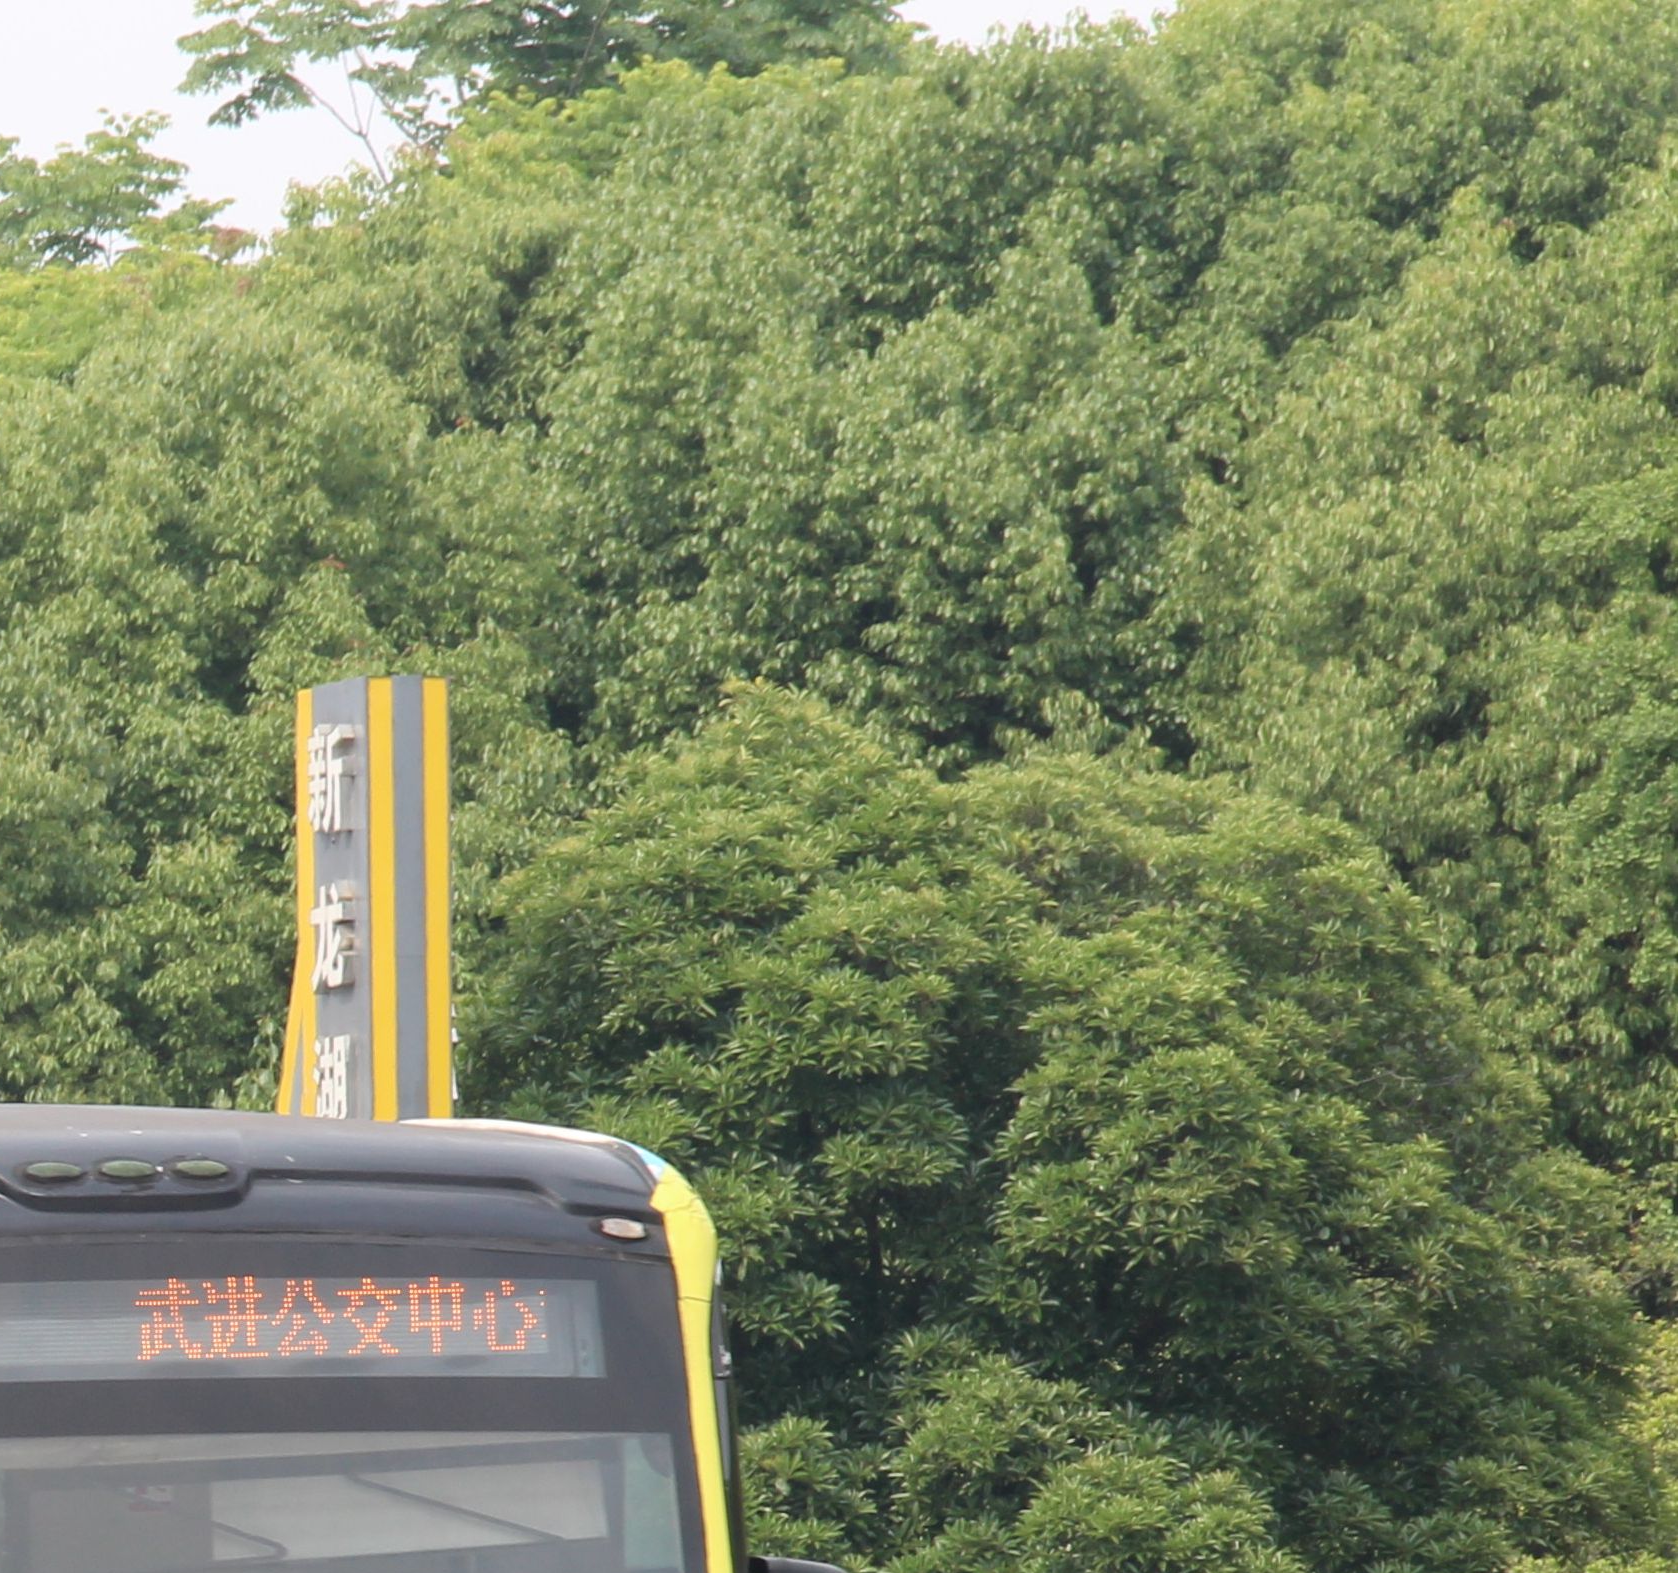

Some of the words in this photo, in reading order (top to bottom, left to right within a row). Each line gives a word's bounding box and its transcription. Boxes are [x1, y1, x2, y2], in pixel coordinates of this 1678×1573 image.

[134, 1275, 539, 1361] 武进公交中心
